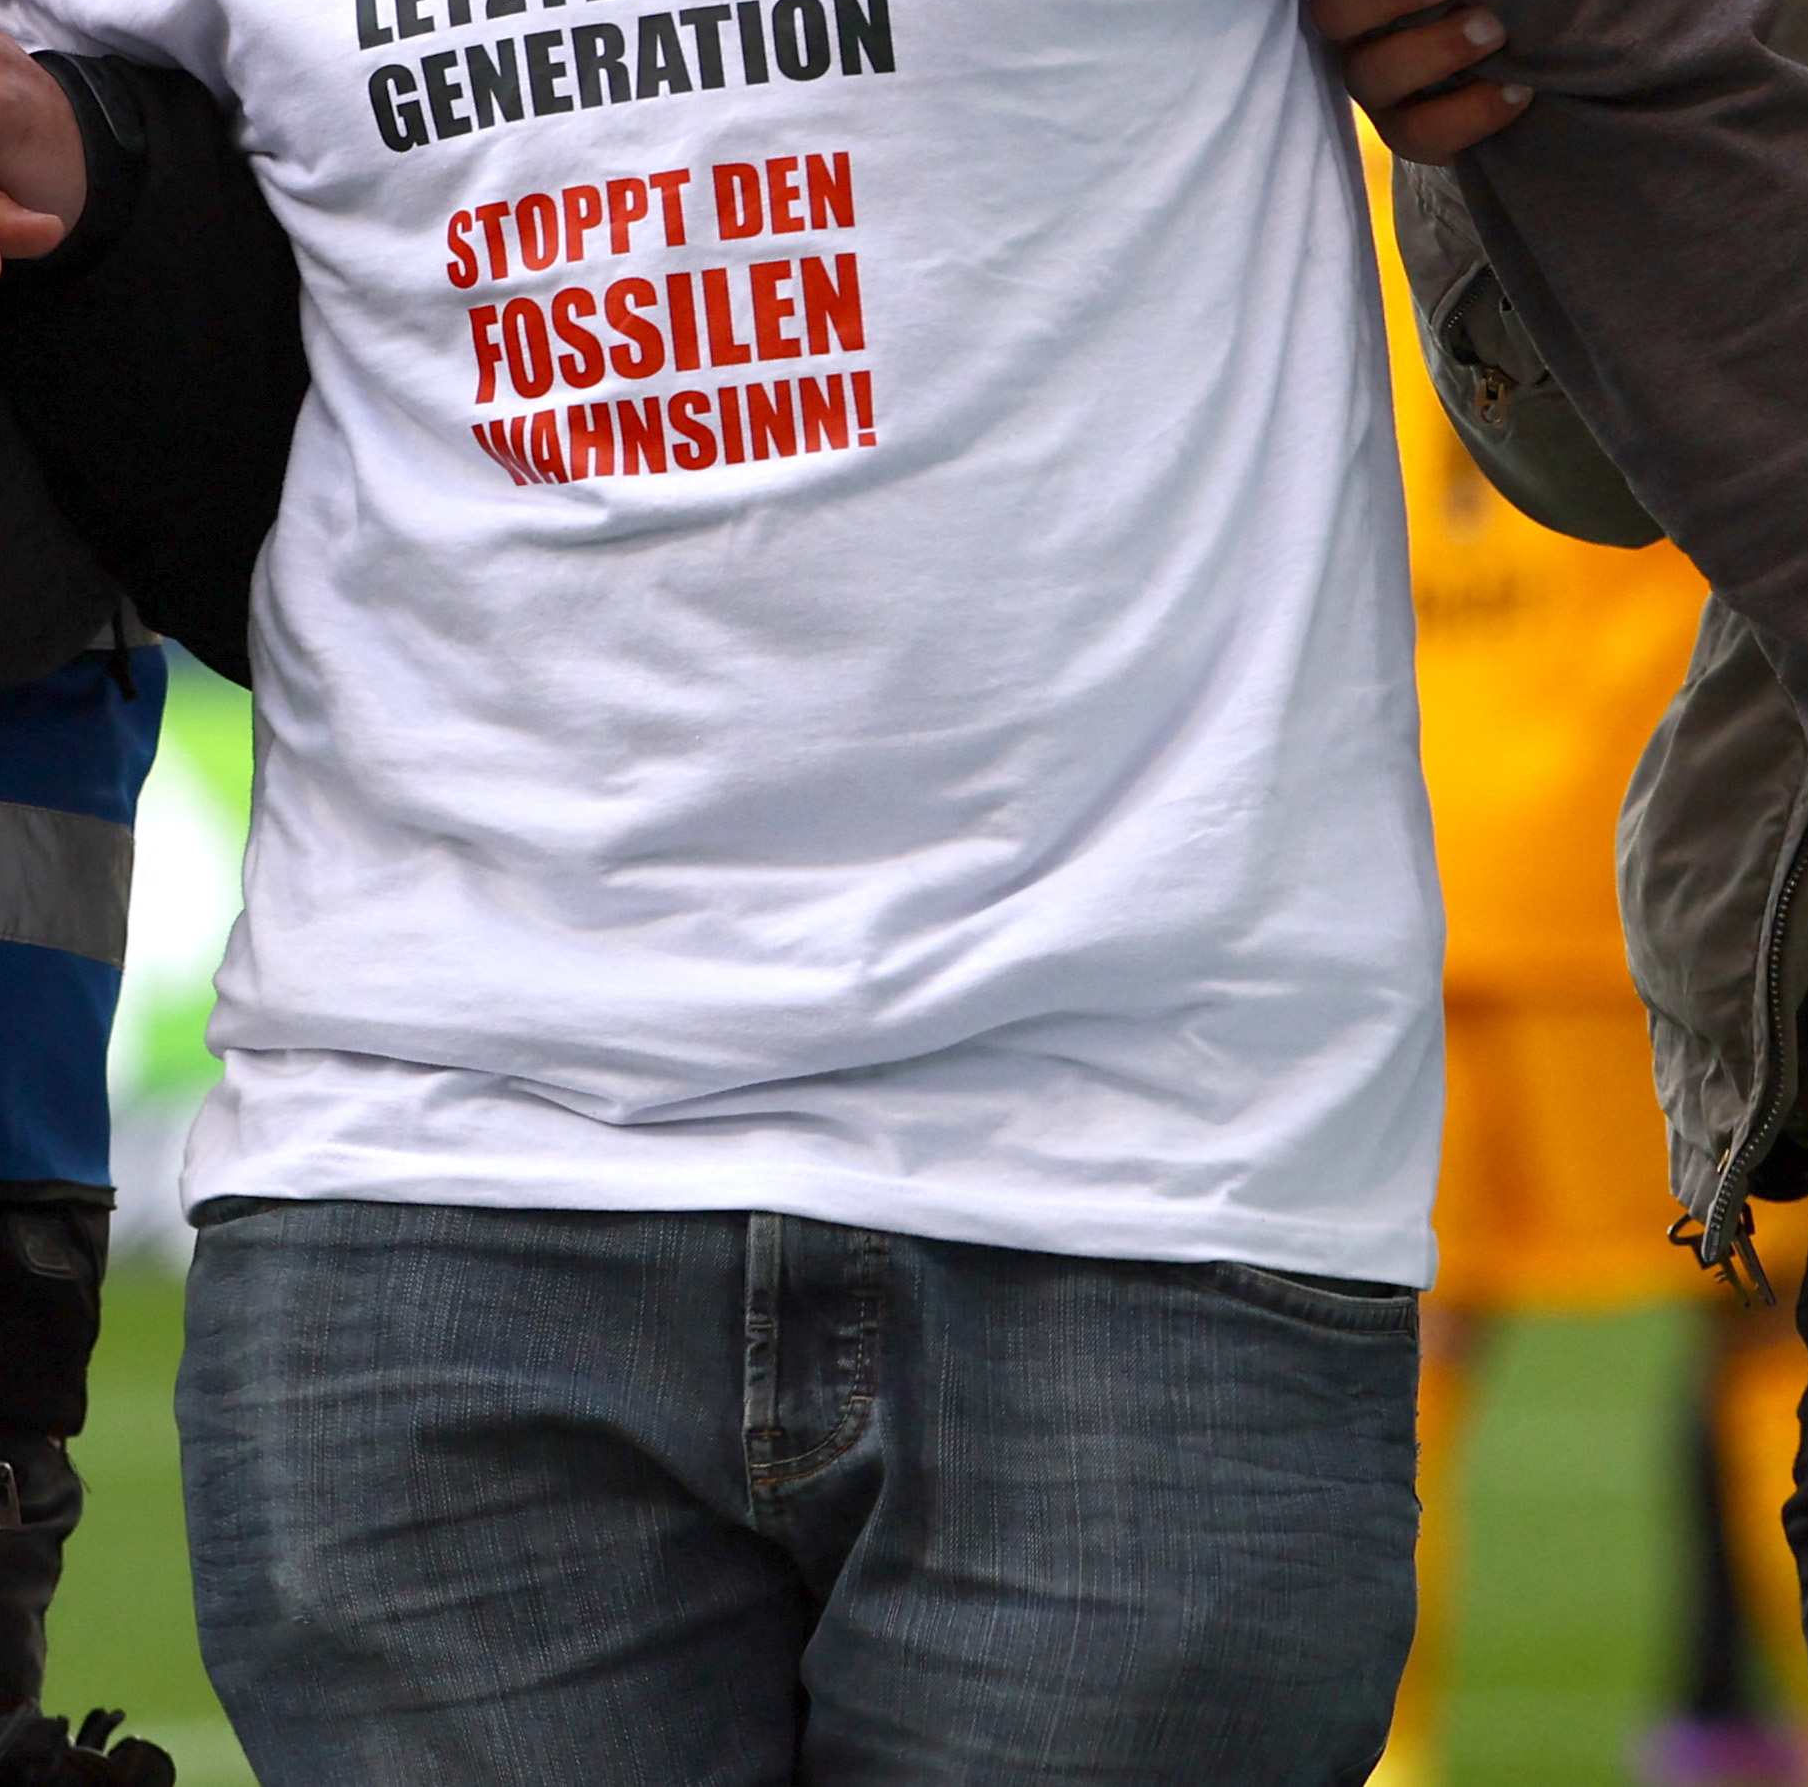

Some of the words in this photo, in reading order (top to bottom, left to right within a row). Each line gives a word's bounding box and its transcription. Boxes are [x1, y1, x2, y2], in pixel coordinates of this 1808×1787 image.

[445, 167, 692, 290] STOPPT
[711, 150, 856, 242] DEN
[467, 252, 867, 405] FOSSILEN
[471, 369, 878, 487] WAHNSINN!
